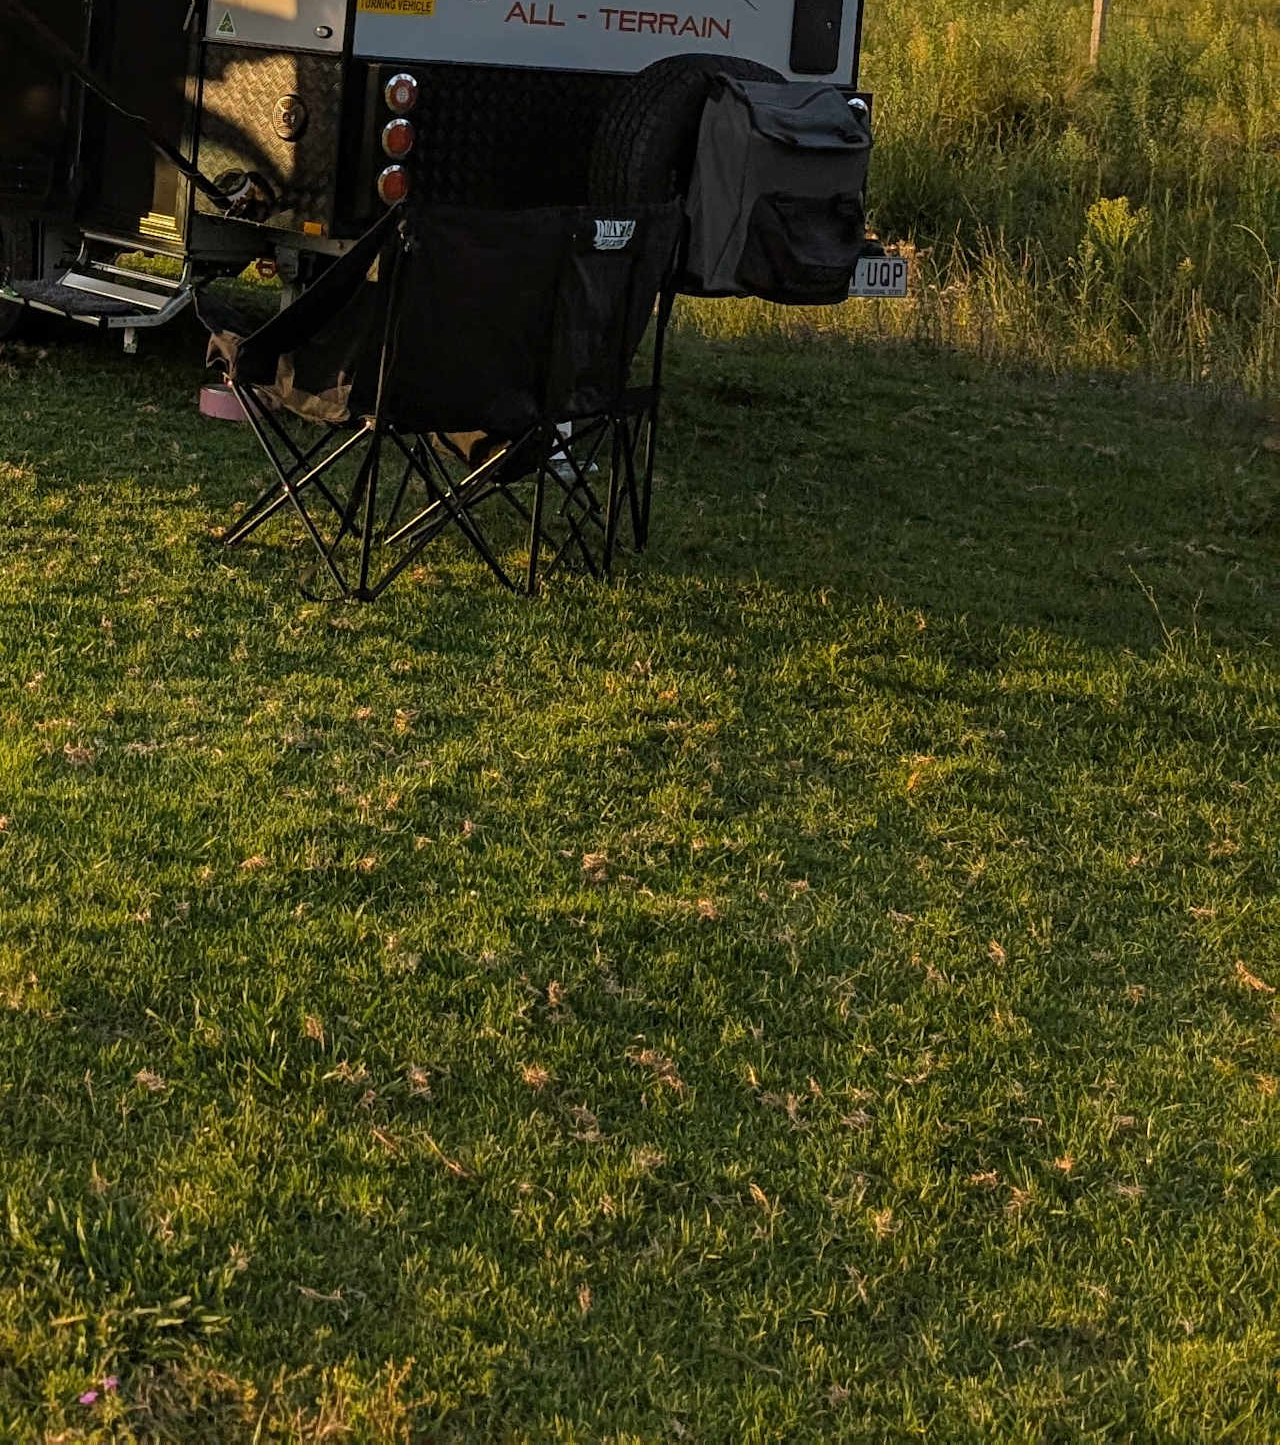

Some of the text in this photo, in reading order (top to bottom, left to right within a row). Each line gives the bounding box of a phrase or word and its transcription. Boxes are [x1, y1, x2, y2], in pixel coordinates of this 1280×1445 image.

[397, 0, 432, 12] VEHICLE
[504, 1, 566, 27] ALL
[599, 8, 731, 40] TERRAIN
